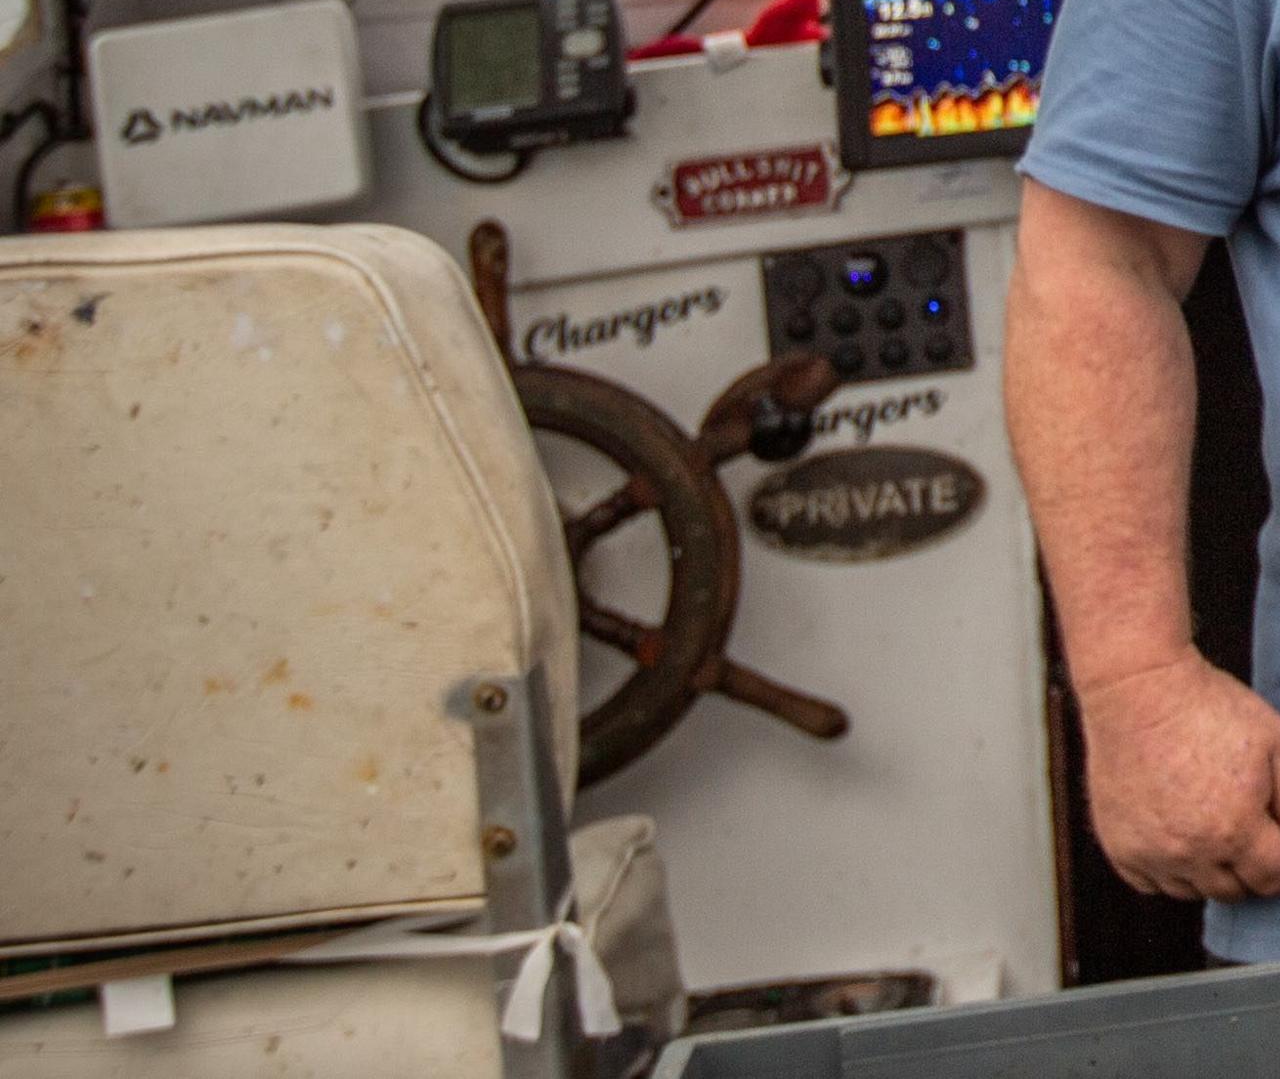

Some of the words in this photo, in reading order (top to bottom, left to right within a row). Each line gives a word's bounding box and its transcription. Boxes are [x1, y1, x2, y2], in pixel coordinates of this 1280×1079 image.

[171, 87, 334, 130] NAVMAN
[523, 286, 722, 357] Chargers
[815, 389, 944, 443] argers
[777, 472, 958, 529] PRIVATE
